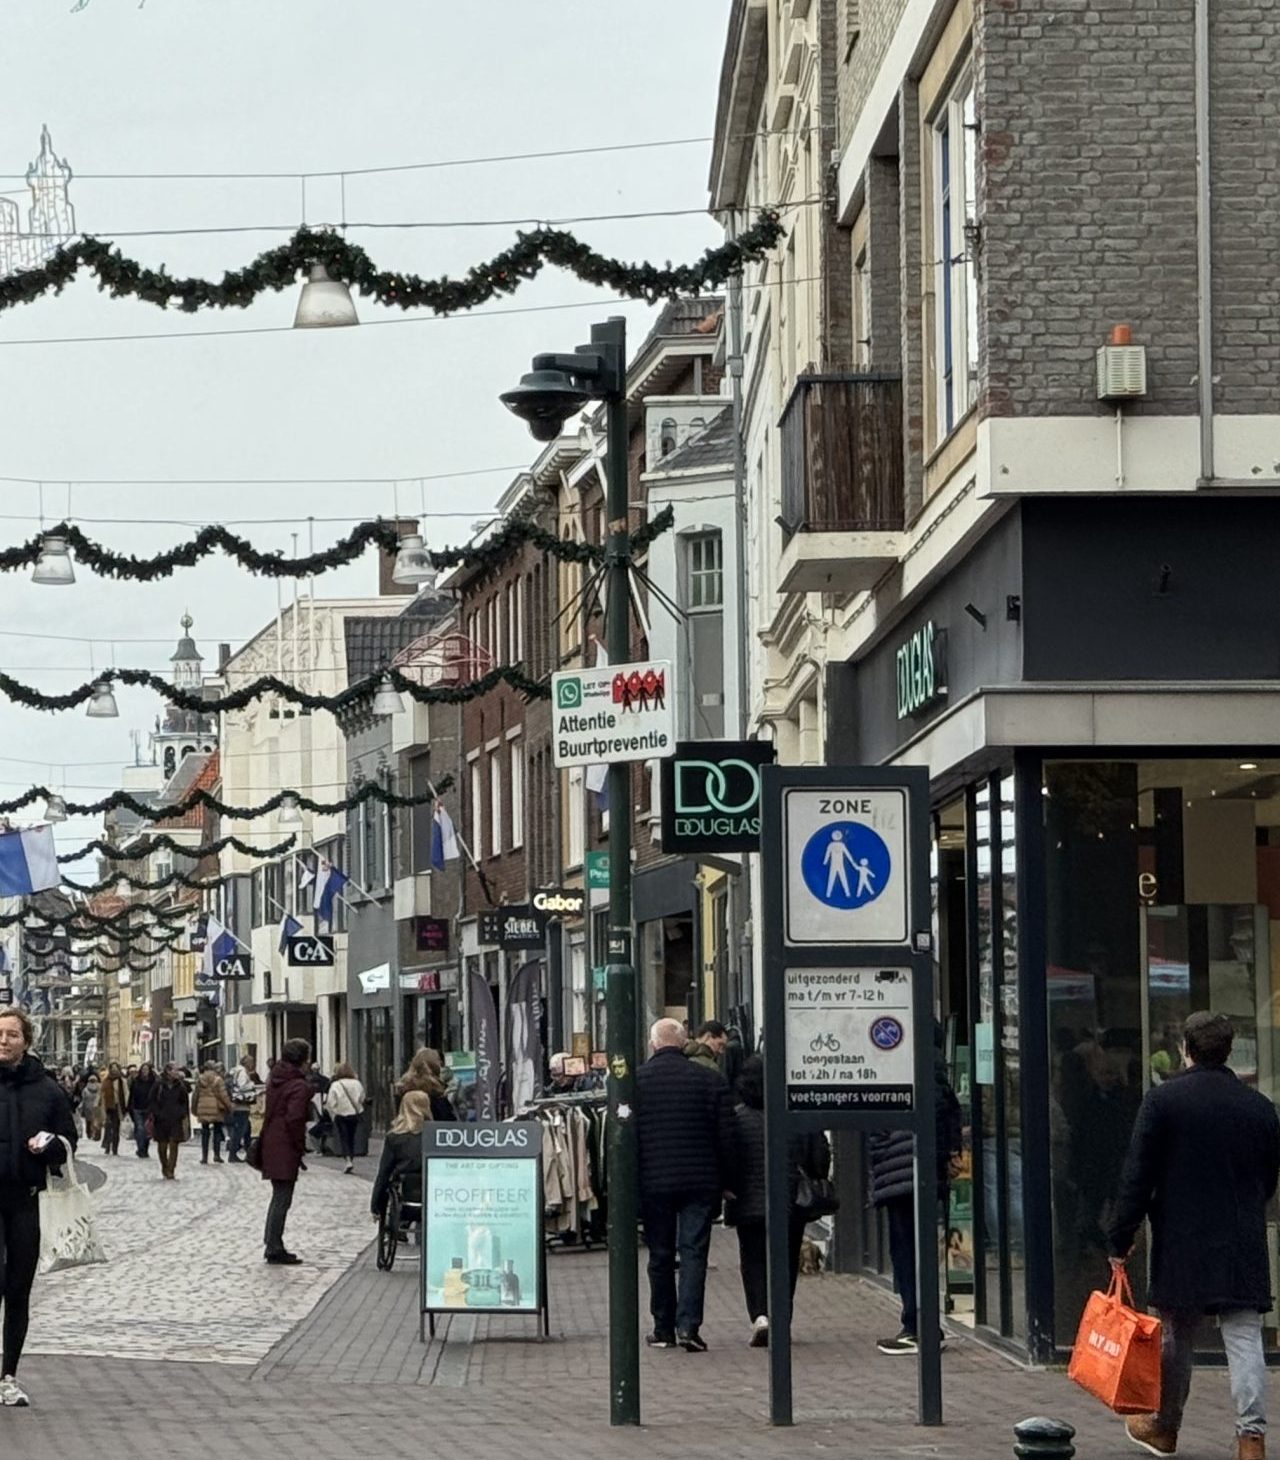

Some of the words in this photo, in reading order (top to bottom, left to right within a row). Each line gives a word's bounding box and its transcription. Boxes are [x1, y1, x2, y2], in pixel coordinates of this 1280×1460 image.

[558, 711, 616, 734] Attentie
[558, 730, 668, 757] Buurtpreventie
[818, 799, 872, 815] ZONE
[675, 817, 760, 836] DOUGLAS
[533, 892, 583, 911] Gabor
[787, 973, 861, 987] uitgezonderd
[788, 992, 805, 1001] ma
[808, 990, 832, 1001] t/m
[835, 992, 847, 1001] vr
[791, 1069, 807, 1080] tot
[839, 1070, 853, 1080] na
[790, 1091, 859, 1106] voetgangers
[861, 1091, 911, 1106] voorrang
[435, 1128, 528, 1147] DOUGLAS
